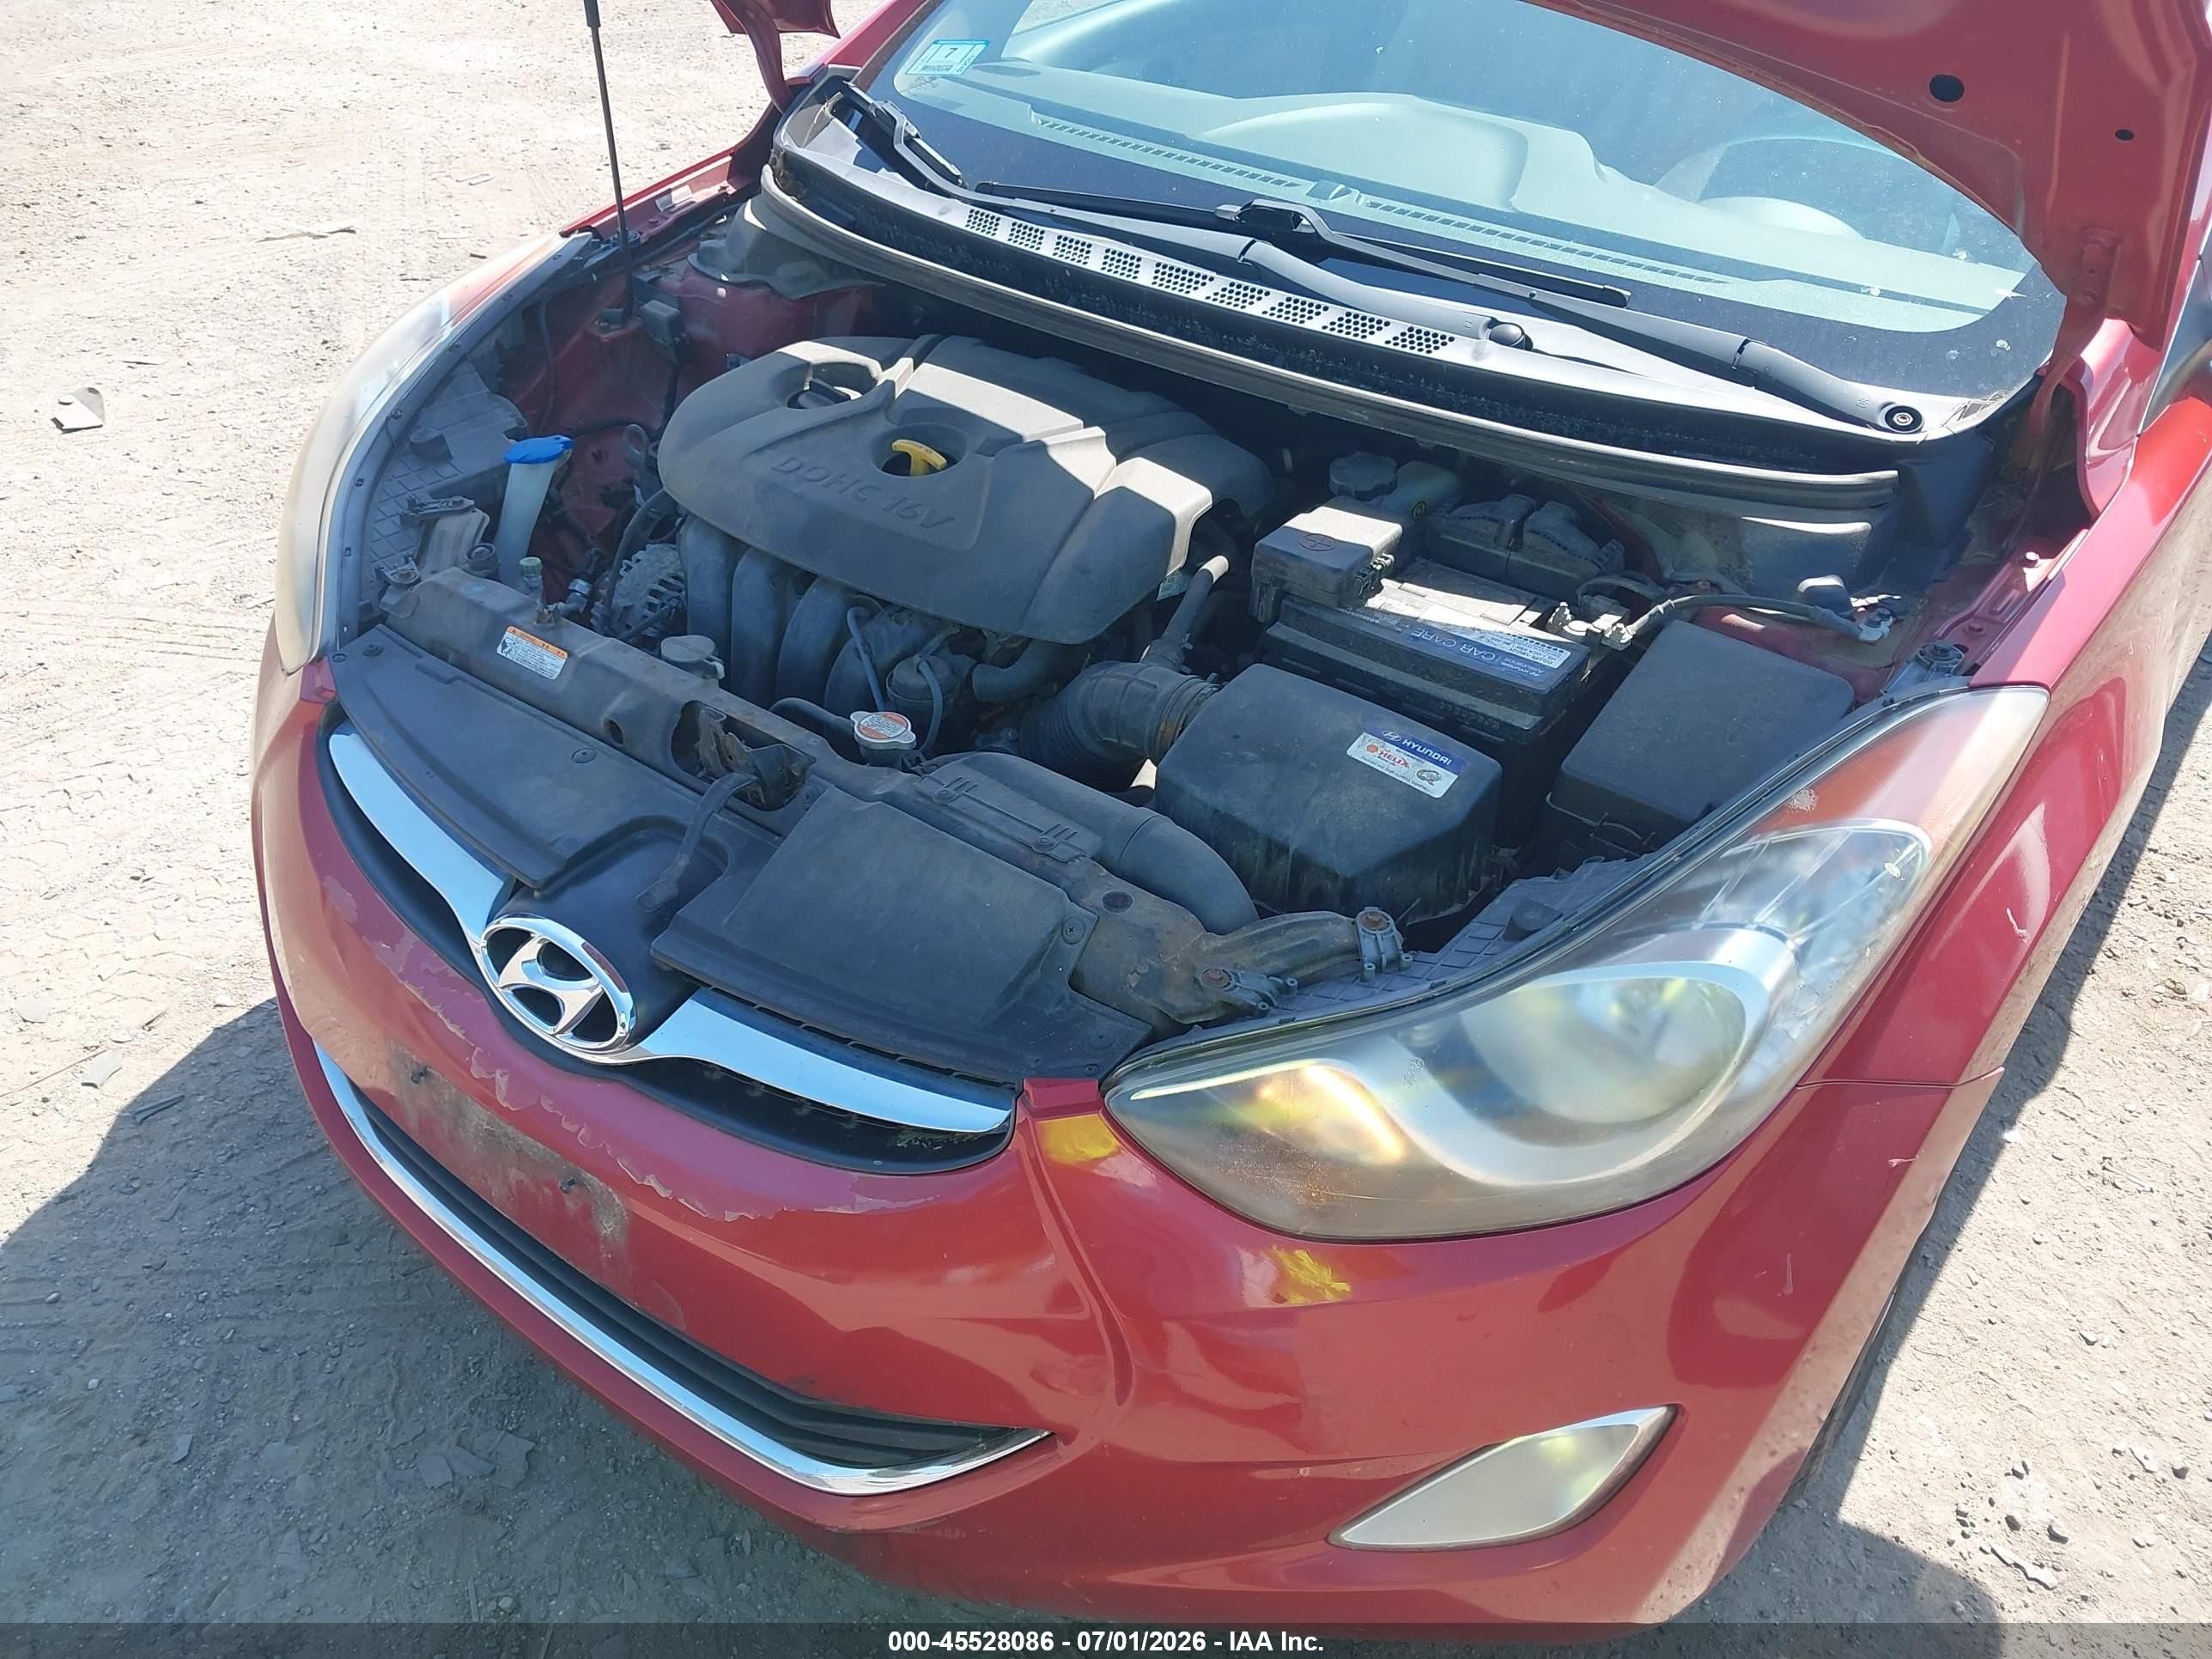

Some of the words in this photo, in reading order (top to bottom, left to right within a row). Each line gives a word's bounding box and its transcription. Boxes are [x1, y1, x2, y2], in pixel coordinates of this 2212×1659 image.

[771, 456, 882, 502] DOHC
[882, 495, 955, 530] 16V
[1411, 628, 1457, 647] CARE
[1460, 642, 1496, 660] CAR
[1379, 750, 1410, 769] HELIX
[1402, 738, 1452, 766] HYUNDAI
